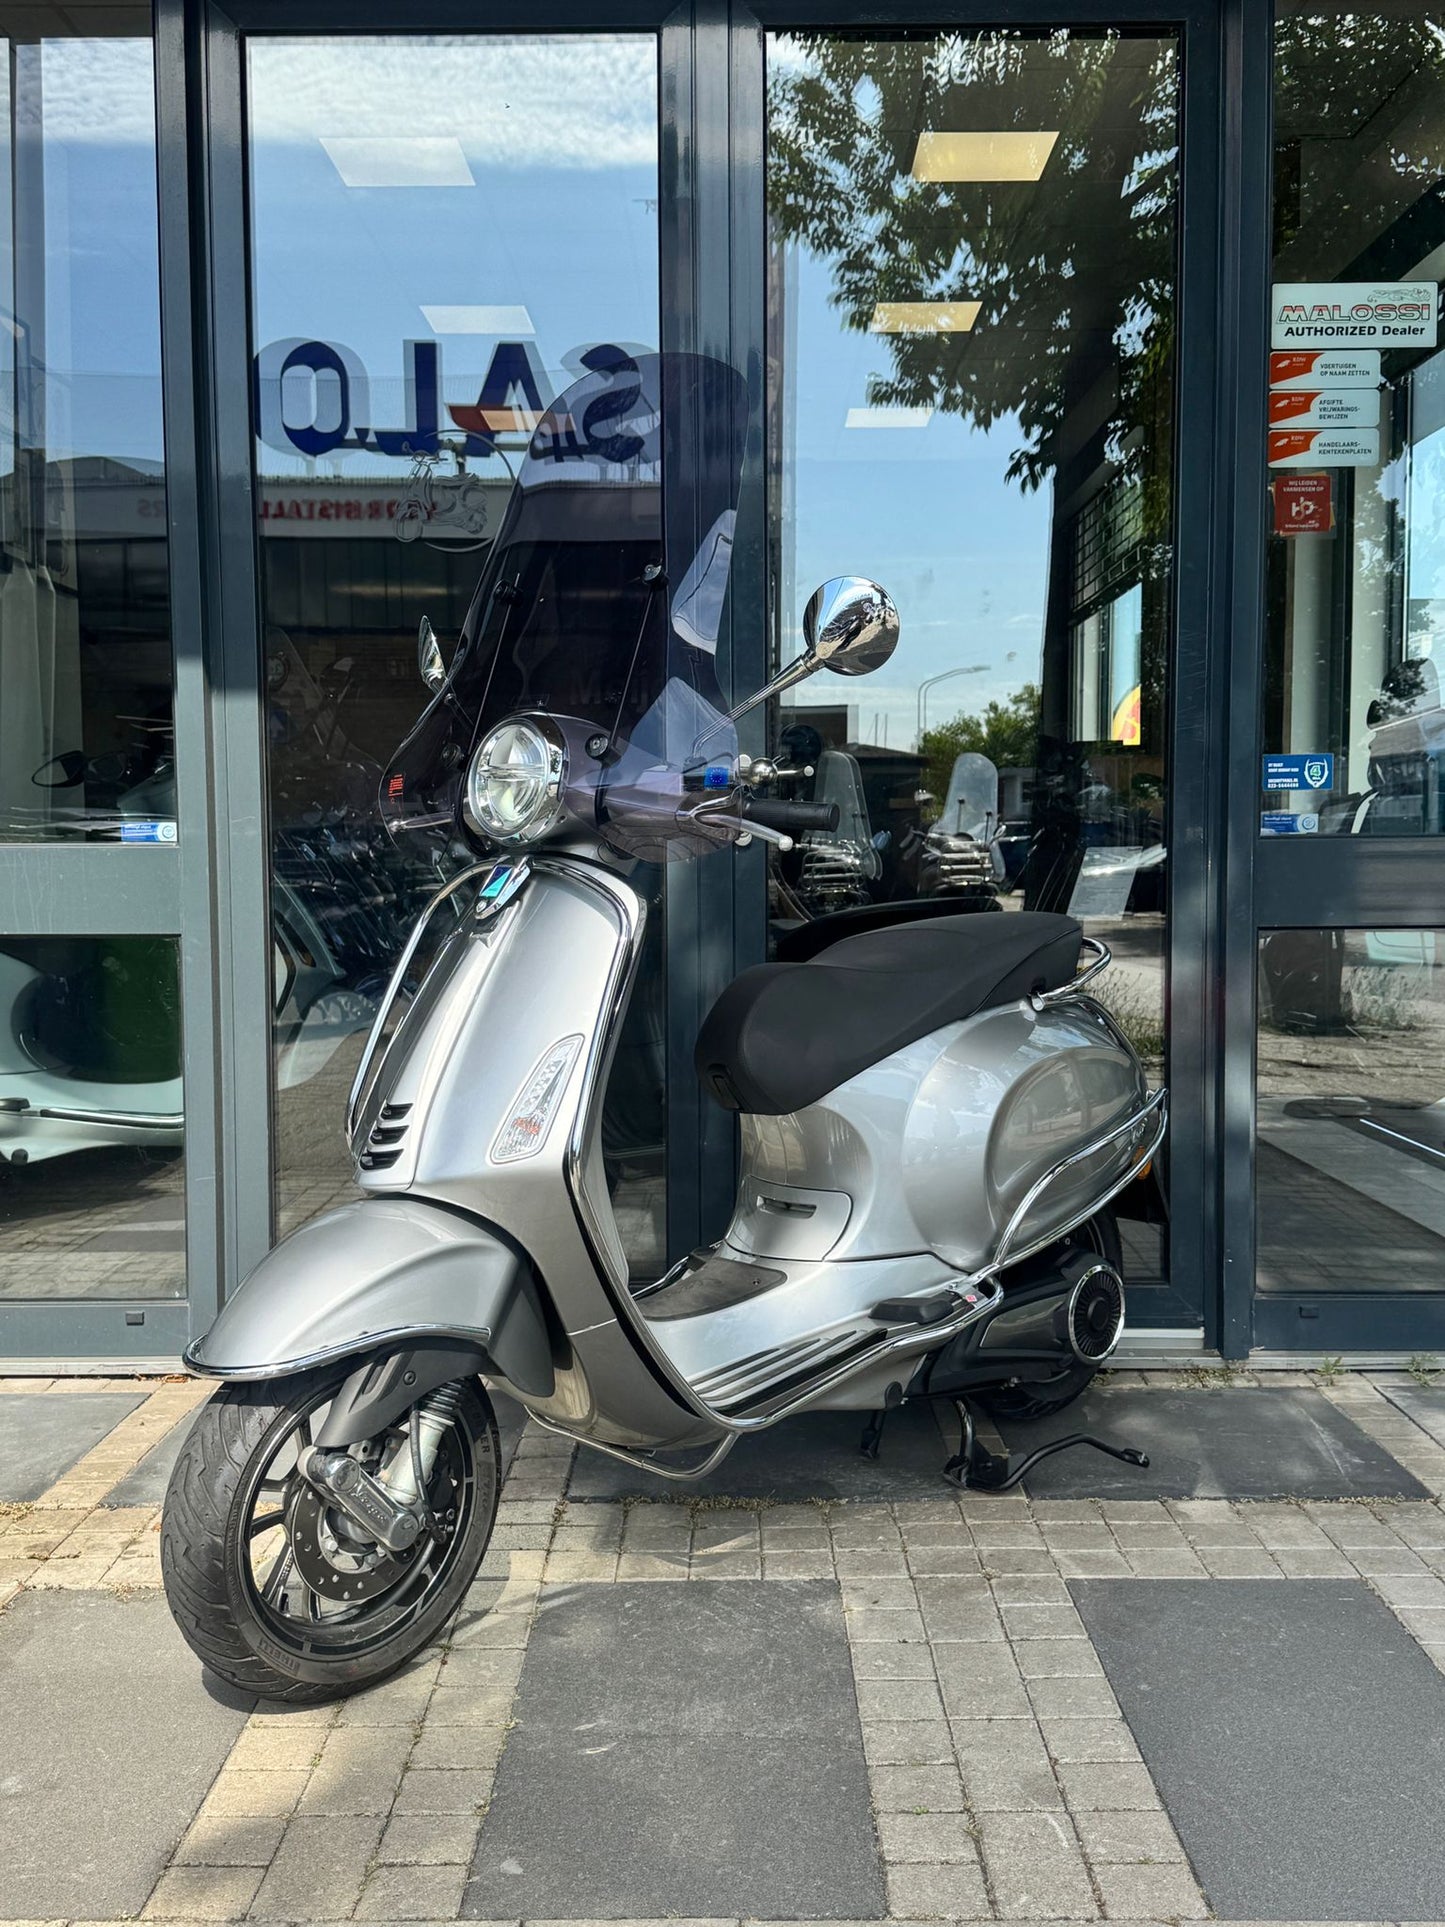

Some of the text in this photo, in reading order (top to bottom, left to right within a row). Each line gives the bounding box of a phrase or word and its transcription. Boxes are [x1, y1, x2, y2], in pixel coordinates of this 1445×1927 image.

[1277, 303, 1431, 323] MALOSSI
[1284, 325, 1426, 337] AUTHORIZED Dealer
